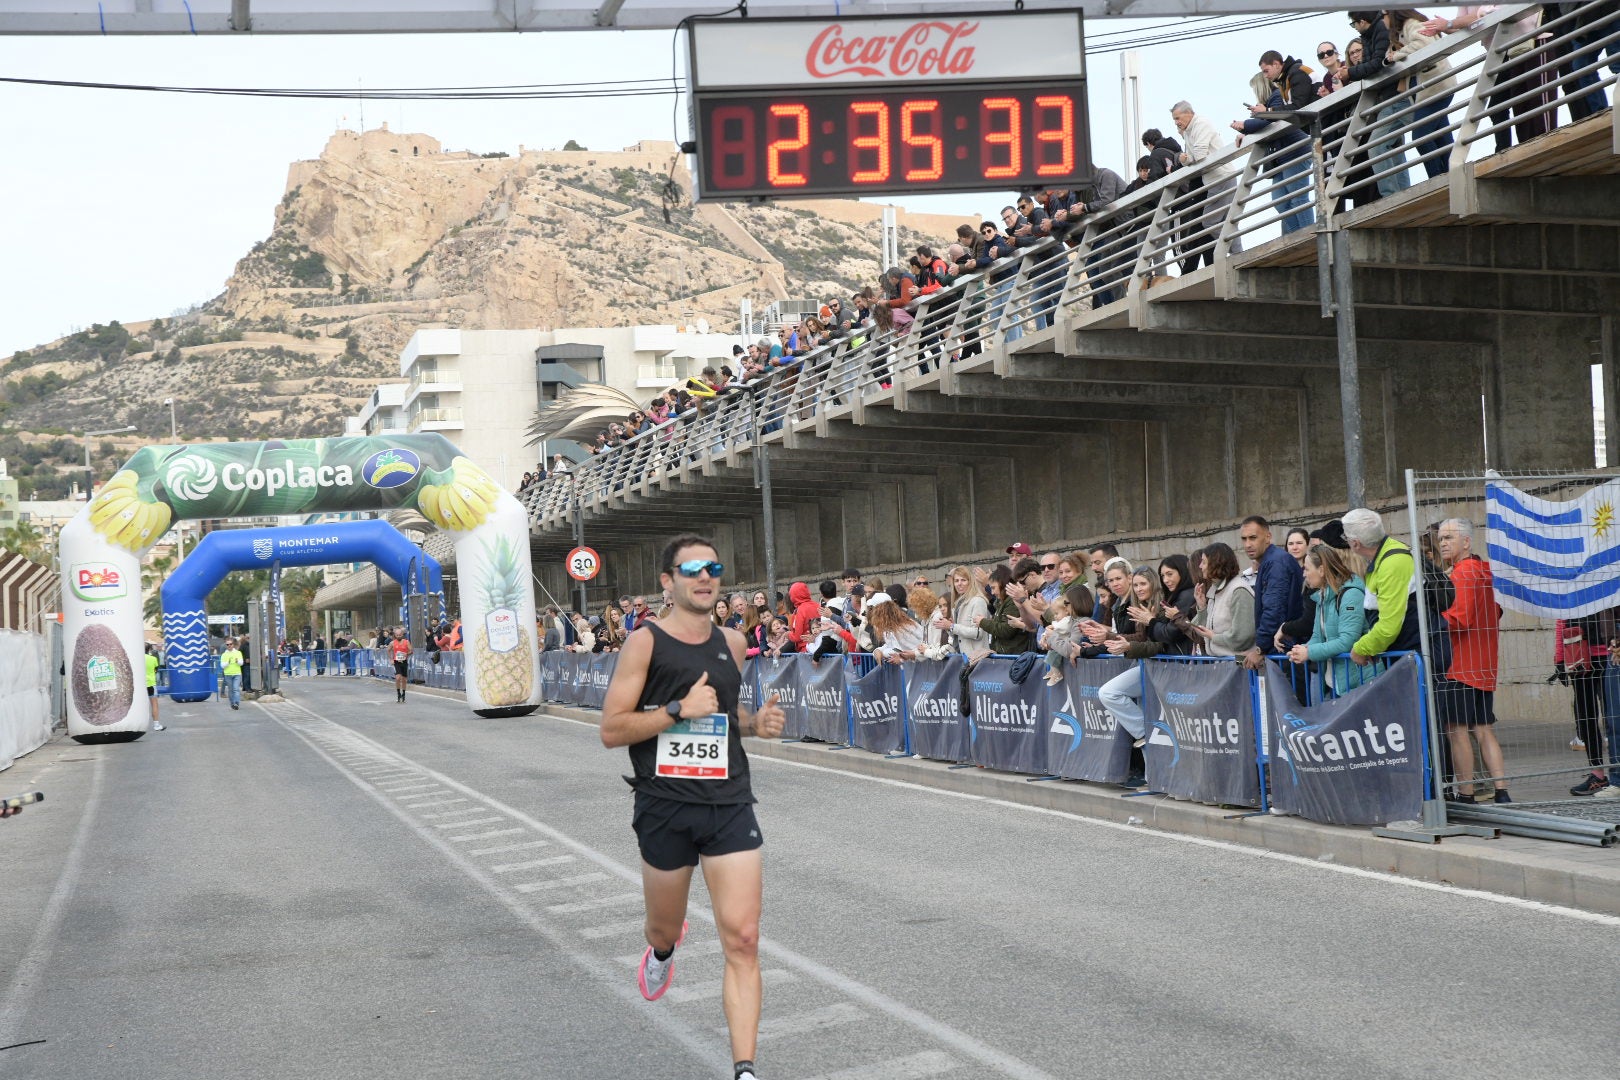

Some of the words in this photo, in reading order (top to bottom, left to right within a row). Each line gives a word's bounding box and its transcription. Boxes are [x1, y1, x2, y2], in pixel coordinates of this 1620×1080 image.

[806, 21, 980, 78] Coca-Cola
[222, 460, 354, 497] Coplaca
[279, 536, 339, 548] MONTEMAR
[575, 558, 593, 569] 30
[79, 568, 119, 586] Dole
[85, 609, 115, 617] Exotics
[973, 681, 1003, 693] DEPORTES
[914, 693, 958, 717] Alicante
[976, 694, 1037, 725] Alicante
[1171, 708, 1239, 744] Alicante
[669, 741, 719, 759] 3458
[1282, 718, 1406, 763] Alicante
